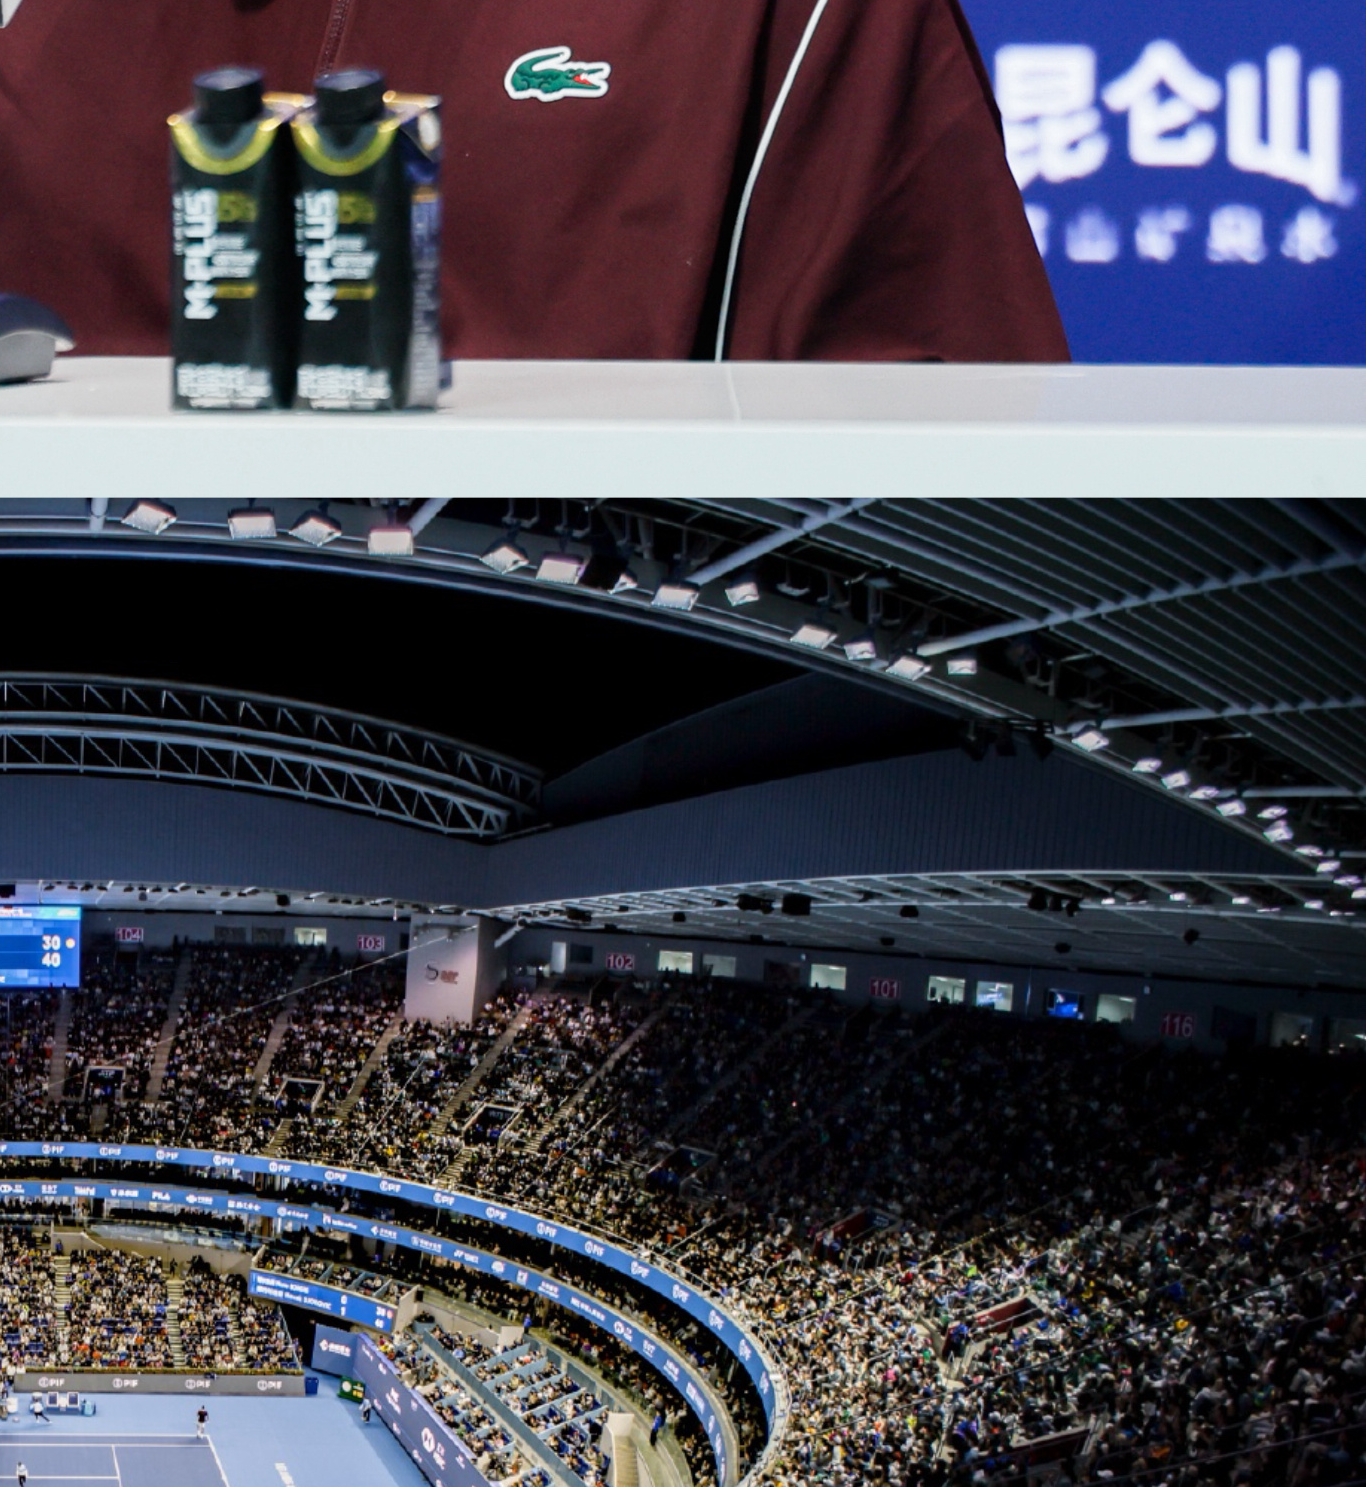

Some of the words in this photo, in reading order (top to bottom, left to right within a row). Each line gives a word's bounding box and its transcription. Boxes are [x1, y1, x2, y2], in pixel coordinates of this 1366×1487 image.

[994, 41, 1356, 208] 昆仑山
[42, 934, 61, 951] 30
[358, 936, 383, 950] 103
[42, 952, 61, 968] 40
[607, 954, 634, 969] 102
[872, 979, 899, 998] 101
[1162, 1014, 1195, 1037] 116
[48, 1378, 65, 1388] PIF
[123, 1378, 138, 1388] PIF
[196, 1379, 211, 1389] PIF
[267, 1380, 283, 1390] PIF
